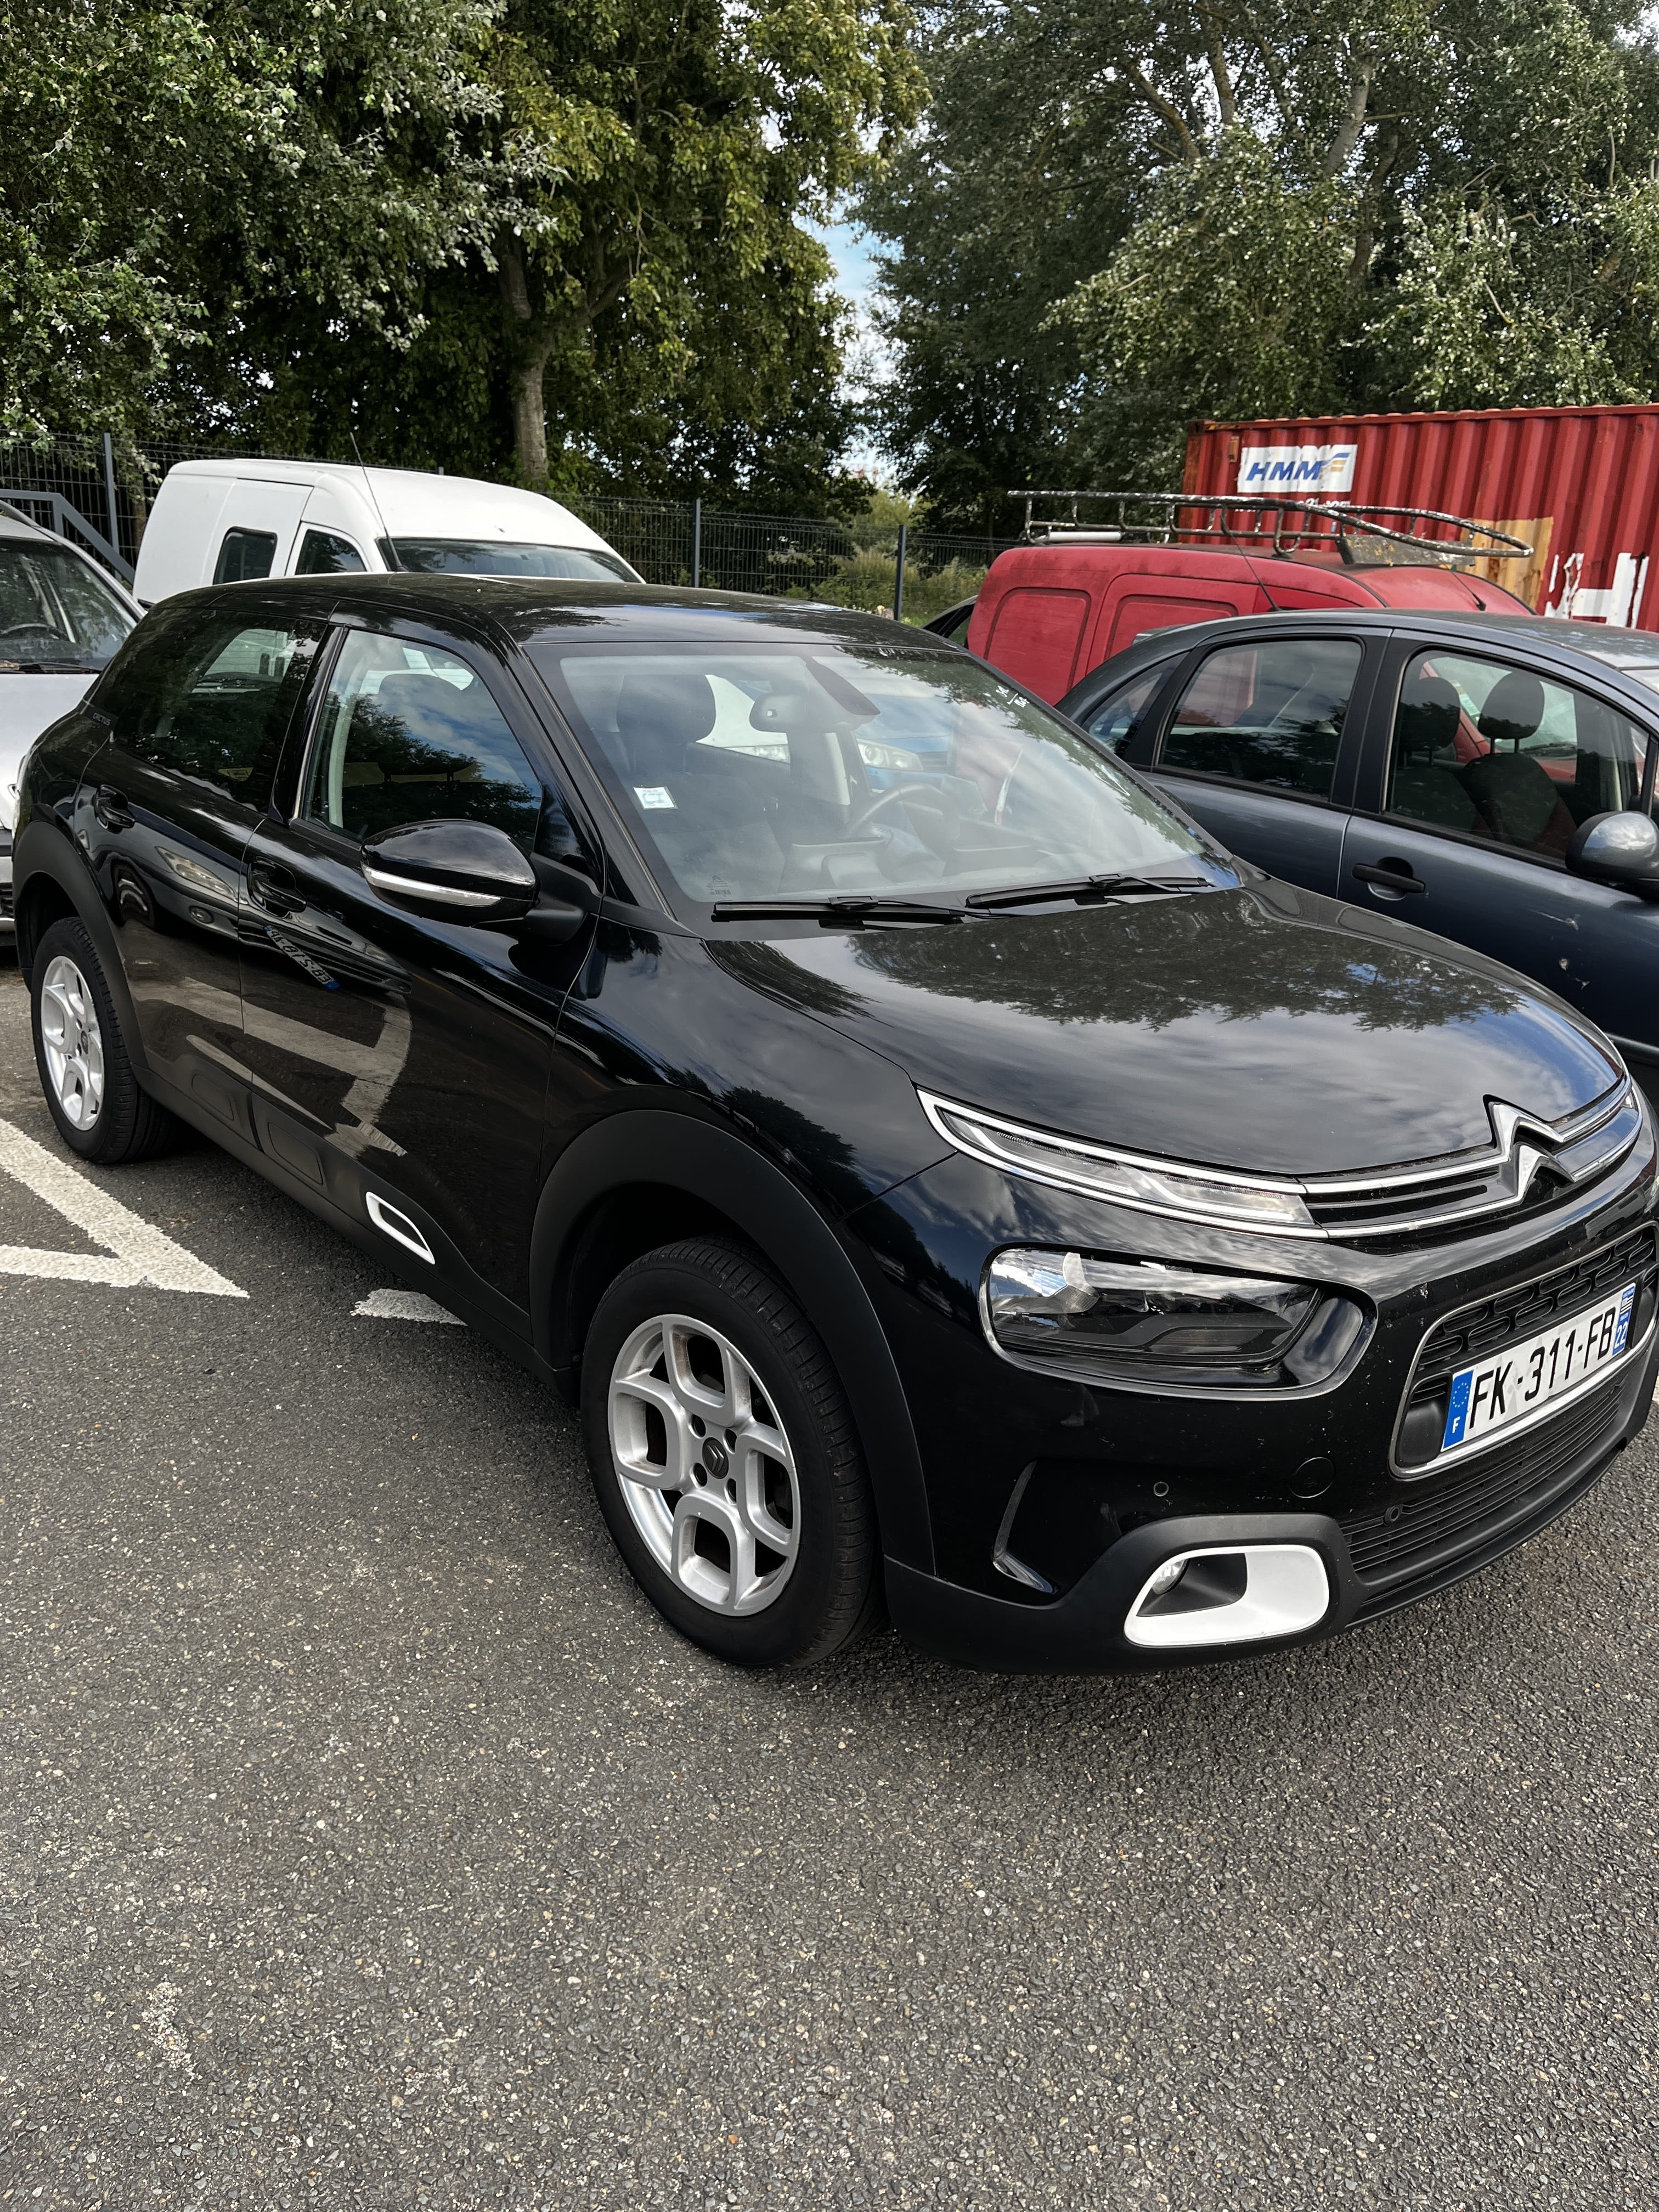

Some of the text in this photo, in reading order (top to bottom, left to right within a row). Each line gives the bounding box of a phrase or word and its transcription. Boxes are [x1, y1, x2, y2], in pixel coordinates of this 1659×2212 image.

[1245, 461, 1323, 481] HMM
[92, 712, 111, 726] CACTUS
[1614, 1321, 1628, 1349] 22
[1469, 1306, 1616, 1429] FK-311-FB
[1452, 1417, 1460, 1434] F
